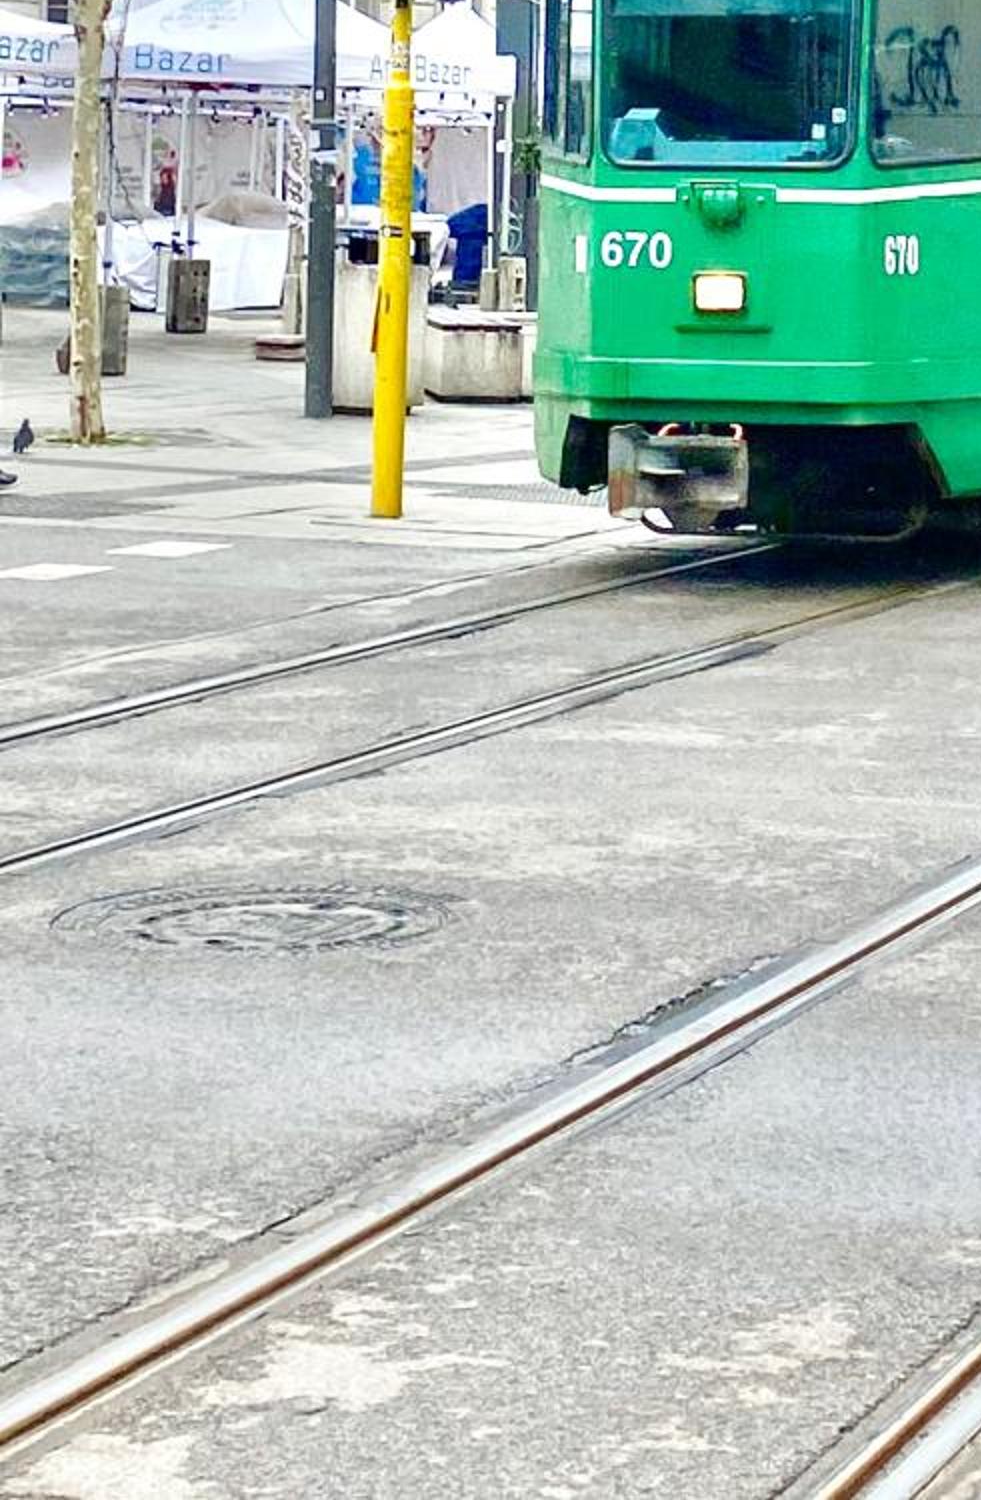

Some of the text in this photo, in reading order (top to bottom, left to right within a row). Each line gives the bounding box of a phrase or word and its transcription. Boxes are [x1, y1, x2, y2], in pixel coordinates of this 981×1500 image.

[0, 35, 61, 63] azar
[134, 43, 231, 74] Bazar
[415, 53, 472, 85] Bazar
[600, 231, 673, 269] 670
[883, 234, 920, 275] 670
